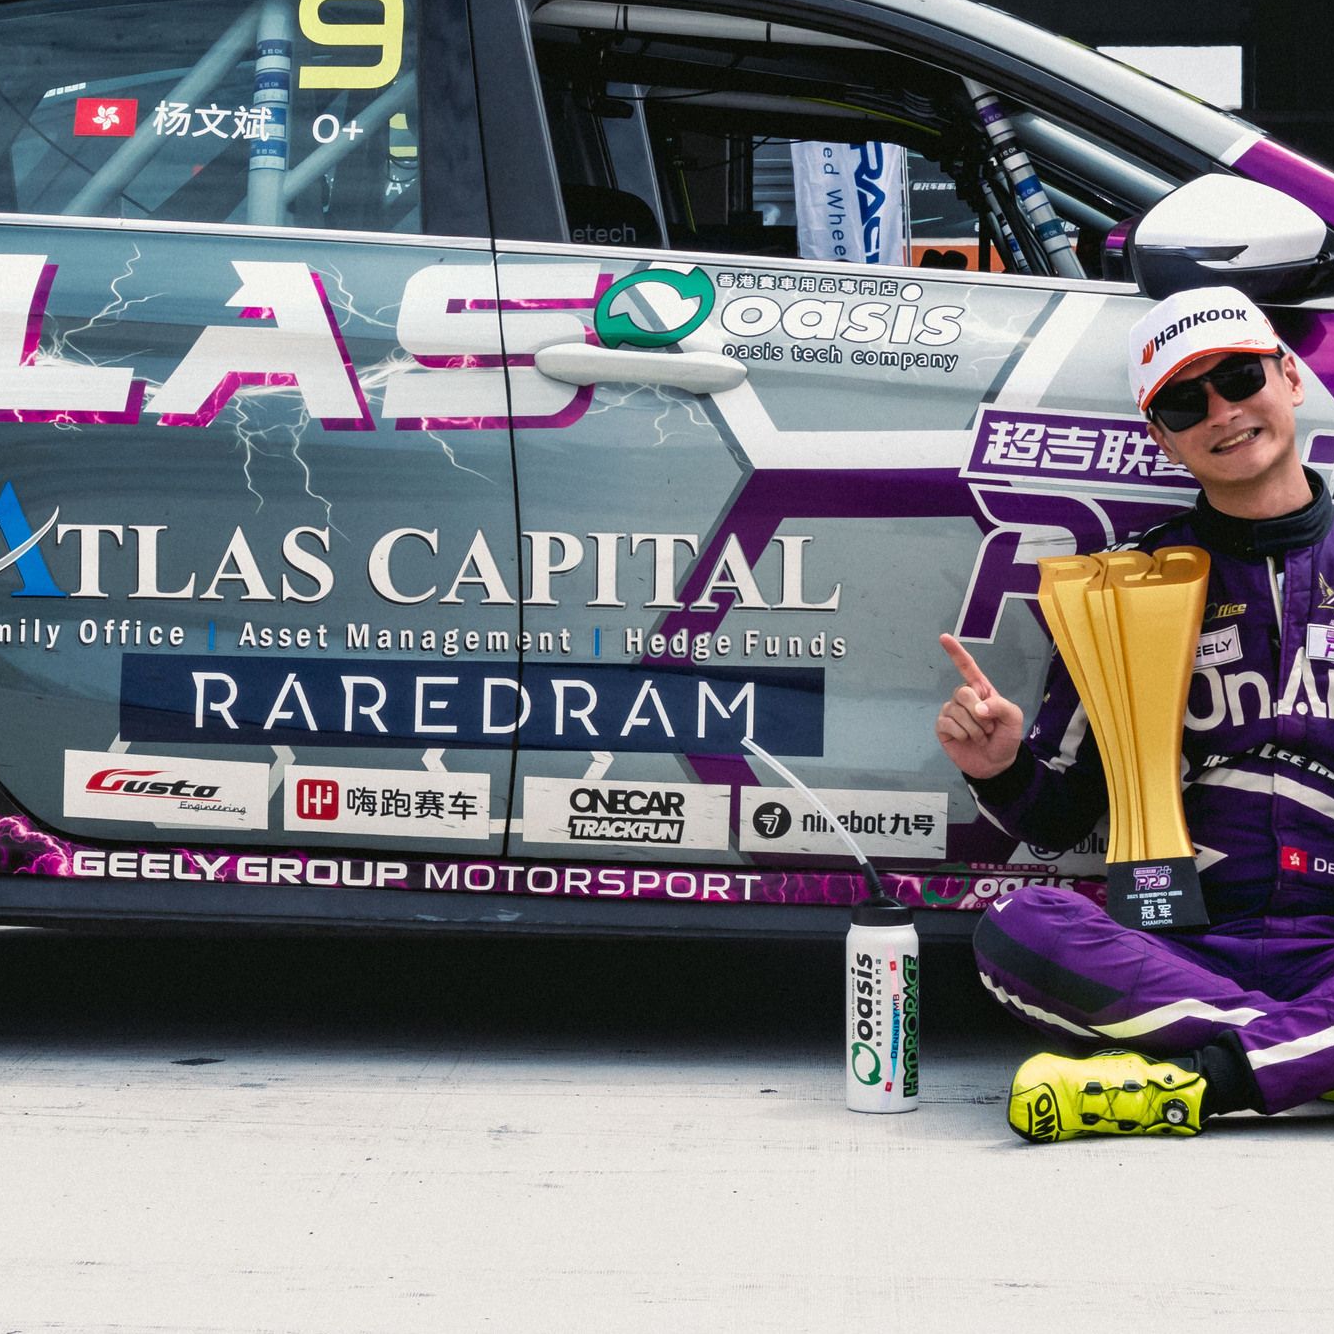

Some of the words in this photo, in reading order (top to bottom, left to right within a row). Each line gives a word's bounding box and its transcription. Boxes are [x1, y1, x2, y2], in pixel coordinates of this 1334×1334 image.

[153, 100, 273, 143] 杨文斌
[717, 272, 899, 297] 香港賽車用品專門店
[721, 282, 965, 347] oasis
[722, 342, 783, 361] oasis
[791, 343, 843, 364] tech
[851, 348, 959, 373] company
[366, 527, 843, 615] CAPITAL
[78, 618, 186, 648] Office
[238, 621, 329, 650] Asset
[345, 623, 572, 659] Management
[624, 628, 733, 663] Hedge
[742, 630, 849, 660] Funds
[1195, 638, 1233, 658] EELY
[190, 670, 757, 740] RAREDRAM
[85, 768, 222, 798] Gusto
[177, 800, 247, 815] Engineering
[346, 786, 478, 821] 嗨跑赛车
[569, 788, 685, 818] ONECAR
[568, 816, 684, 844] TRACKFUN
[889, 813, 935, 837] 九号
[72, 850, 224, 883] GEELY
[236, 856, 408, 888] GROUP
[424, 863, 762, 901] MOTORSPORT
[1141, 904, 1172, 919] 冠军
[1141, 918, 1173, 926] CHAMPION
[851, 952, 873, 1041] oasis
